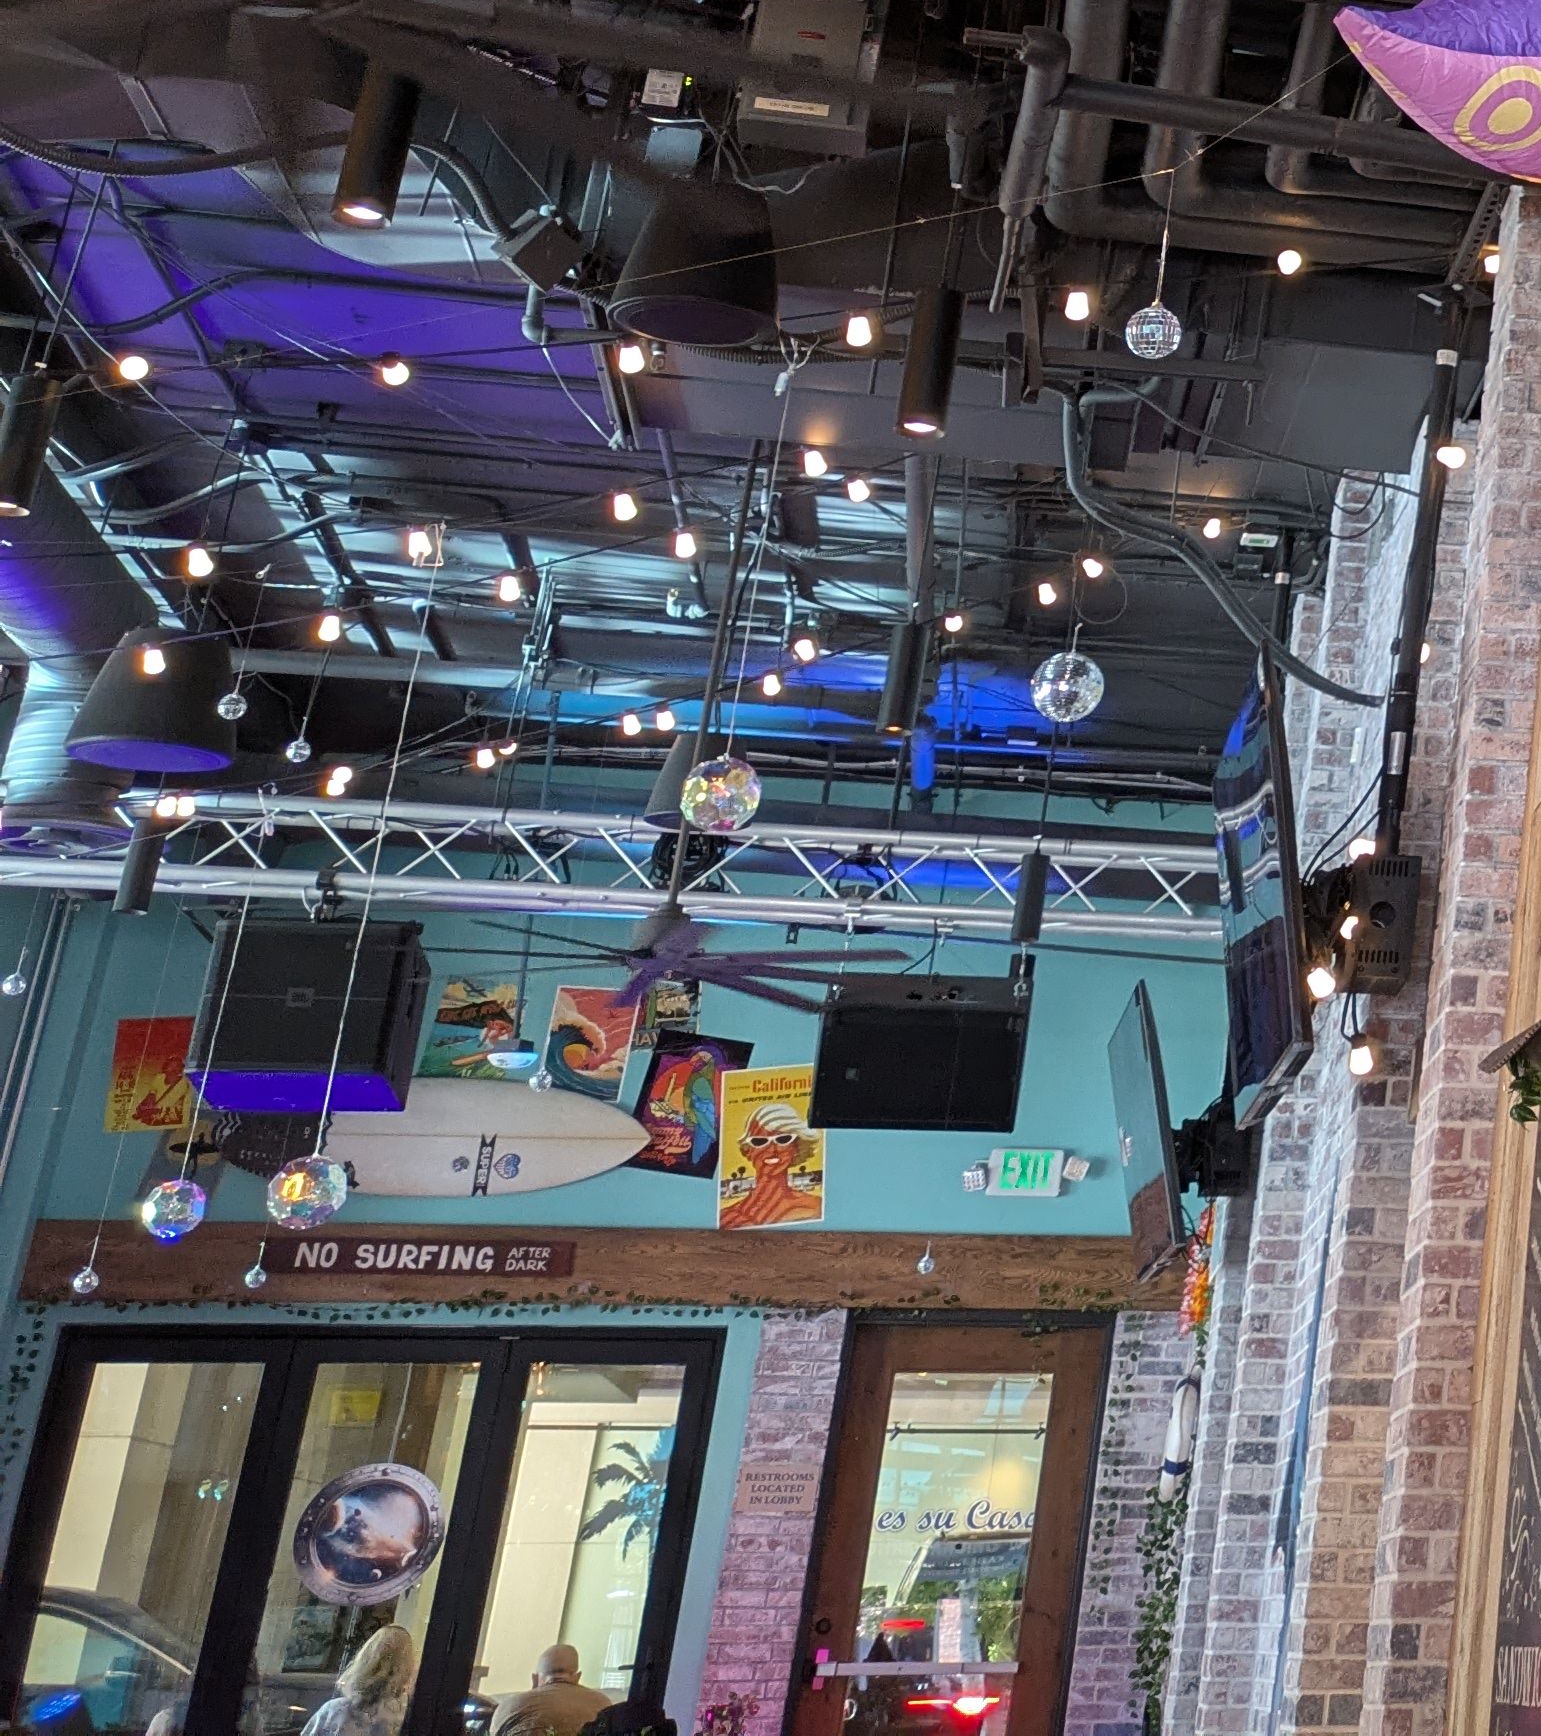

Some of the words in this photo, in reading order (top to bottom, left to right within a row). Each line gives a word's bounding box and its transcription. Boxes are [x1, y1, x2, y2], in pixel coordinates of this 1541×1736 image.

[752, 1076, 812, 1093] Californi
[476, 1146, 492, 1184] SUPER
[999, 1151, 1055, 1190] EXIT
[294, 1242, 339, 1269] NO
[355, 1244, 495, 1272] SURFING
[507, 1246, 552, 1260] AFTER
[504, 1259, 548, 1272] DARK
[745, 1472, 815, 1482] RESTROOMS
[751, 1484, 805, 1494] LOCATED
[749, 1495, 762, 1505] IN
[764, 1495, 803, 1505] LOBBY
[876, 1510, 906, 1531] es
[917, 1509, 956, 1531] su
